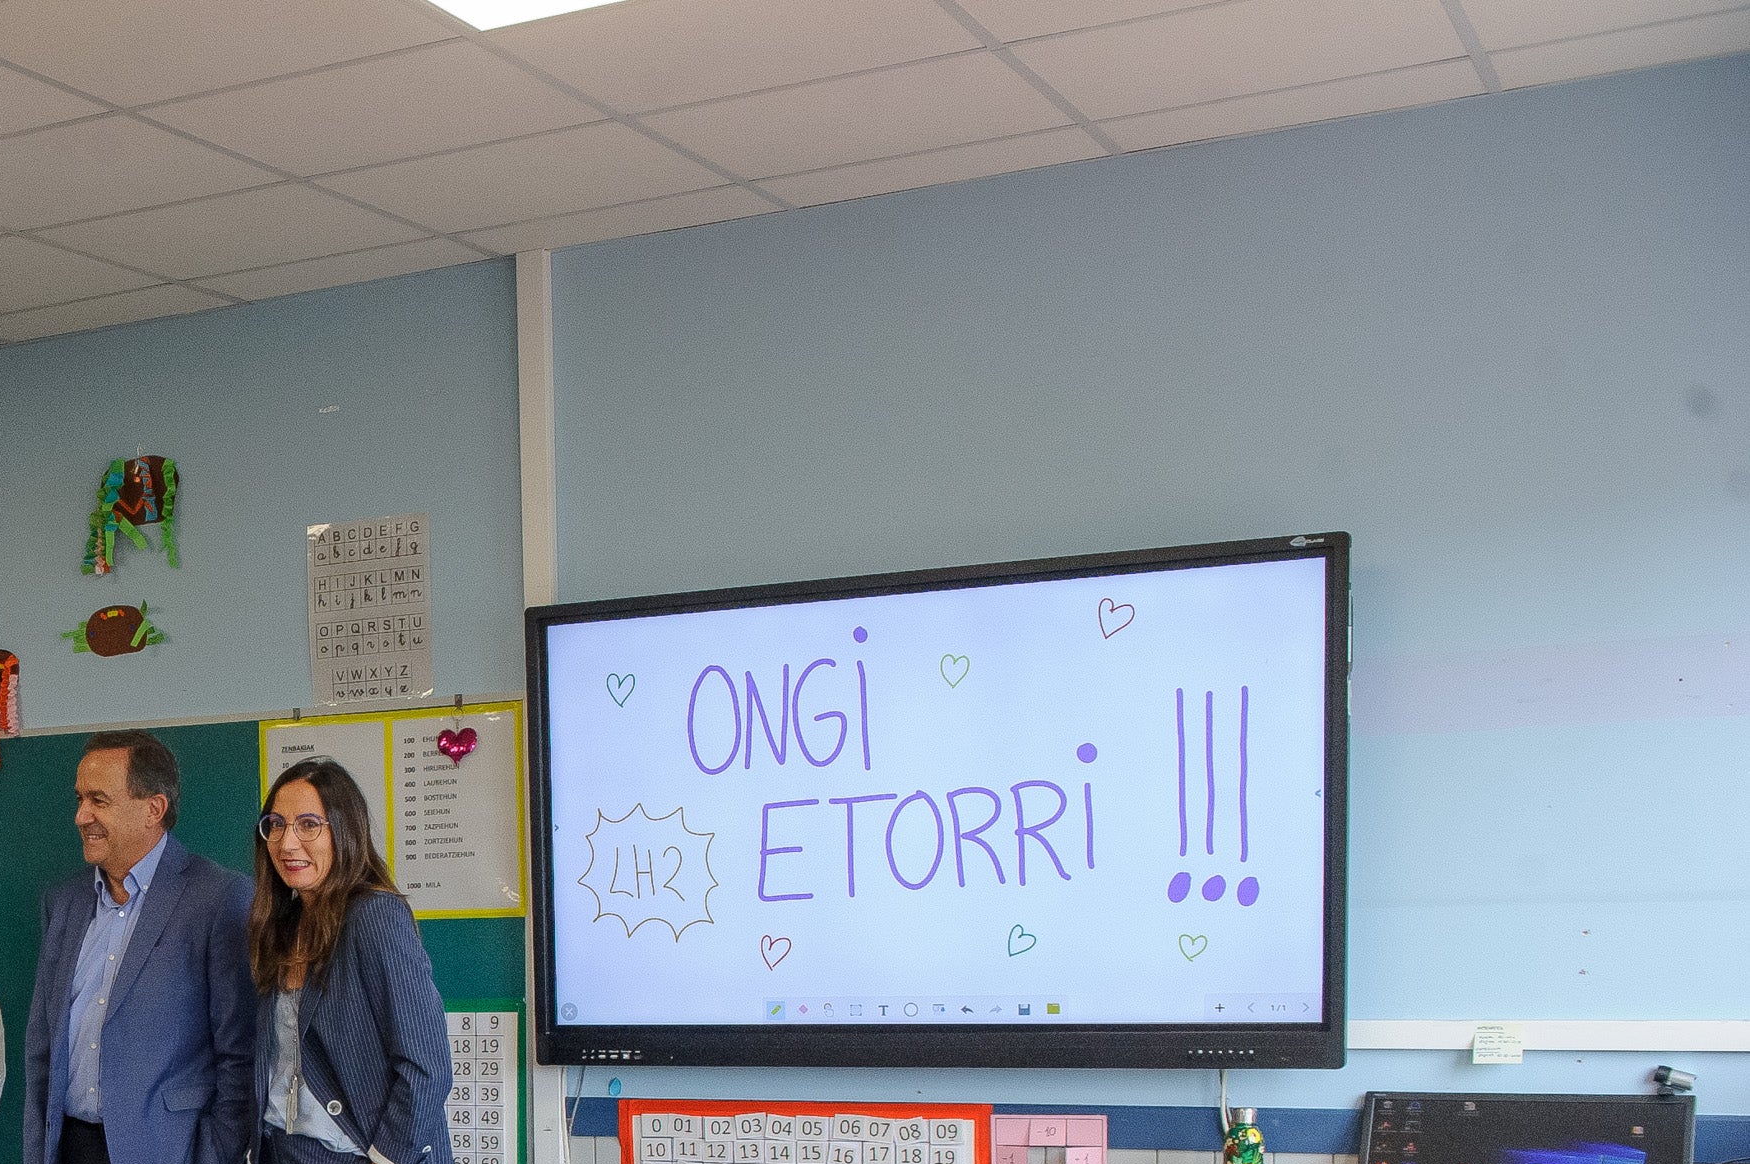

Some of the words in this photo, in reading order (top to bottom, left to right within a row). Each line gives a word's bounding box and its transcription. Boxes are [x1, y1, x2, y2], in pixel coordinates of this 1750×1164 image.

[318, 533, 326, 544] A
[333, 531, 340, 542] B
[348, 529, 356, 540] C
[364, 527, 372, 538] D
[380, 525, 387, 536] E
[396, 523, 402, 534] F
[410, 521, 419, 532] G
[608, 844, 687, 903] LH2
[462, 1017, 471, 1030] 8
[490, 1016, 499, 1030] 9
[453, 1039, 471, 1054] 18
[481, 1039, 499, 1053] 19
[453, 1062, 471, 1076] 28
[481, 1062, 499, 1076] 29
[452, 1087, 471, 1101] 38
[481, 1088, 499, 1101] 39
[452, 1110, 471, 1124] 48
[481, 1111, 499, 1124] 49
[651, 1120, 662, 1133] 0
[673, 1119, 692, 1133] 01
[710, 1122, 731, 1135] 02
[741, 1119, 763, 1134] 03
[771, 1121, 792, 1136] 04
[802, 1122, 823, 1136] 05
[839, 1120, 861, 1135] 06
[869, 1123, 891, 1137] 07
[899, 1124, 921, 1141] 08
[936, 1125, 958, 1139] 09
[453, 1135, 471, 1148] 58
[481, 1136, 499, 1149] 59
[646, 1143, 666, 1157] 10
[679, 1142, 697, 1157] 11
[708, 1144, 725, 1159] 12
[740, 1144, 759, 1159] 13
[771, 1146, 790, 1161] 14
[802, 1146, 821, 1161] 15
[833, 1148, 854, 1164] 16
[869, 1147, 889, 1161] 17
[902, 1149, 922, 1164] 18
[935, 1151, 955, 1164] 19
